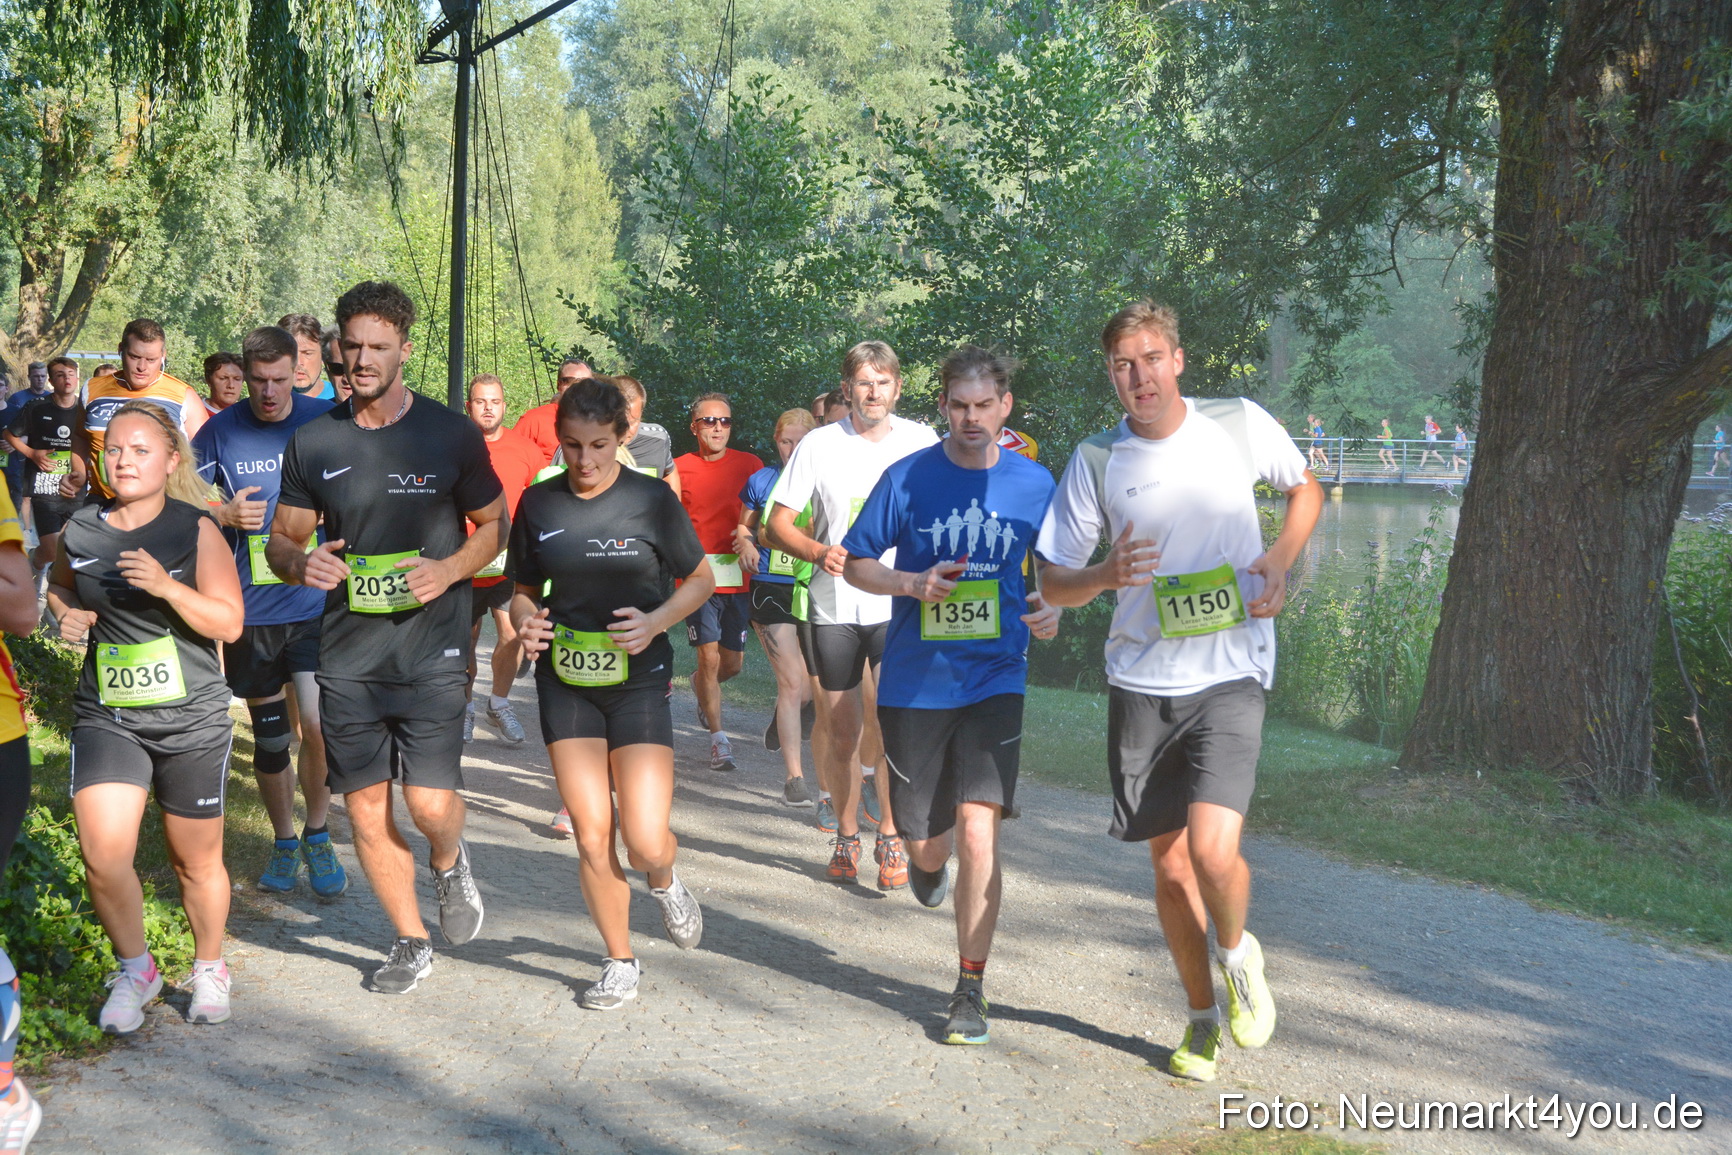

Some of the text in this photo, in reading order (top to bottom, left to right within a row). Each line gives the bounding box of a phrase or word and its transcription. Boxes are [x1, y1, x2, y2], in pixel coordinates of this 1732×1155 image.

[236, 459, 277, 474] EURO
[354, 573, 411, 597] 2033
[379, 595, 407, 604] Benjamin
[1167, 589, 1230, 618] 1150
[931, 601, 989, 623] 1354
[559, 647, 616, 671] 2032
[106, 662, 170, 689] 2036
[565, 668, 594, 677] Muratovic
[136, 686, 167, 695] Christina
